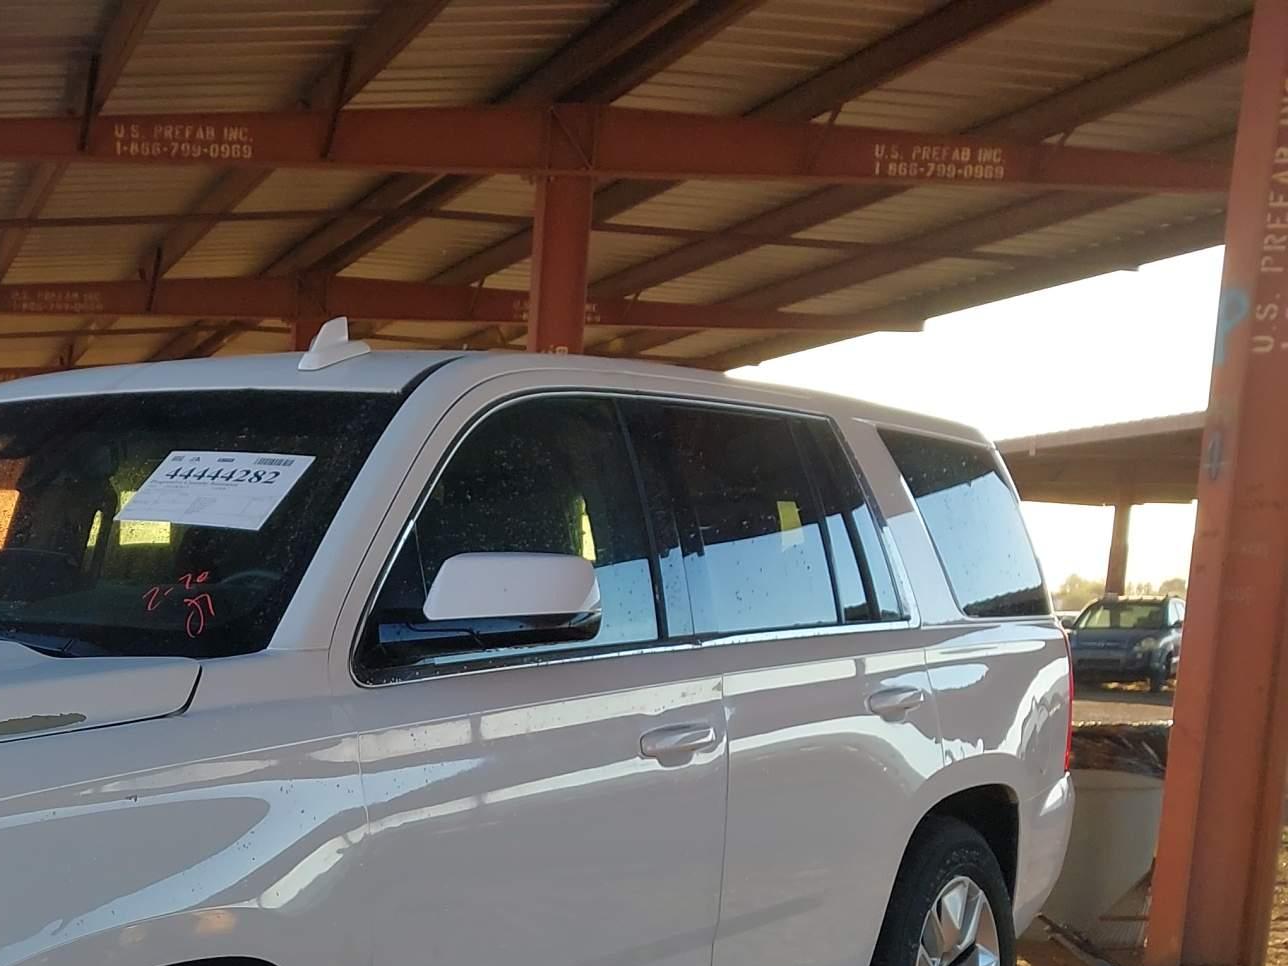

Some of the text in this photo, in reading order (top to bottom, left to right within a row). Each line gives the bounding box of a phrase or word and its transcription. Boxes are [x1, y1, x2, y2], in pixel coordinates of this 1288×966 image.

[153, 125, 216, 141] PREFAB
[223, 127, 254, 143] INC.
[874, 143, 904, 160] U.S.
[911, 145, 972, 162] PREFAB
[1250, 292, 1281, 354] U.S.
[165, 466, 281, 485] 44444282
